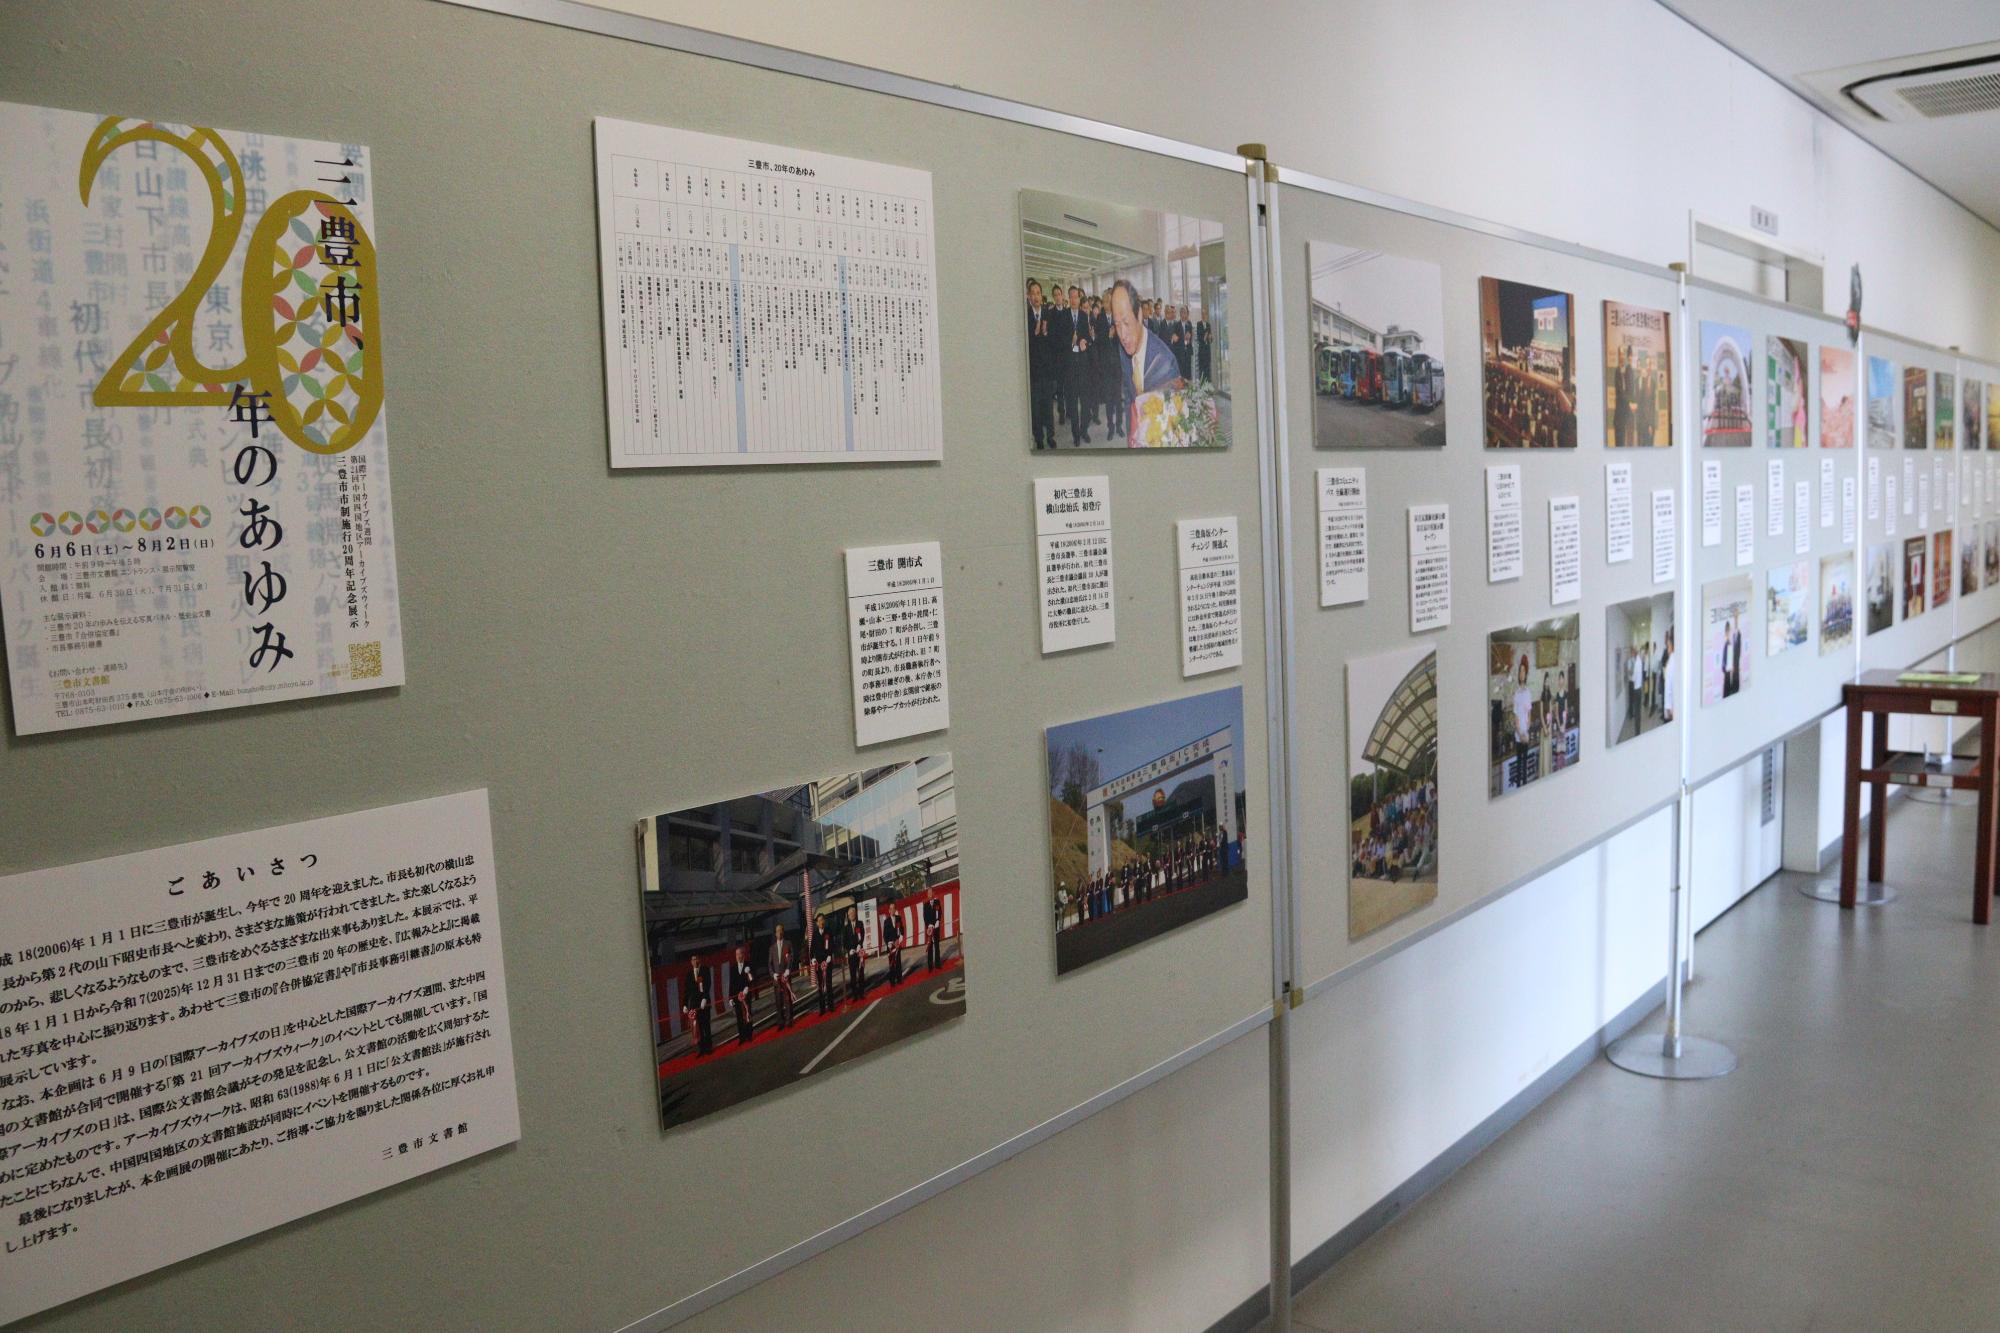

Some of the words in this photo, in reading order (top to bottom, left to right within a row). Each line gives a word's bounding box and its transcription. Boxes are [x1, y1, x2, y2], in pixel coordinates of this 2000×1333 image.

[1054, 488, 1093, 499] 初代三豊市長
[228, 383, 294, 673] 年のあゆみ
[336, 455, 359, 629] 三豊市市制施行20周年記念展示
[868, 557, 894, 572] 三豊市
[381, 1122, 469, 1161] 三豊市文書館
[6, 1221, 79, 1254] し上げます。
